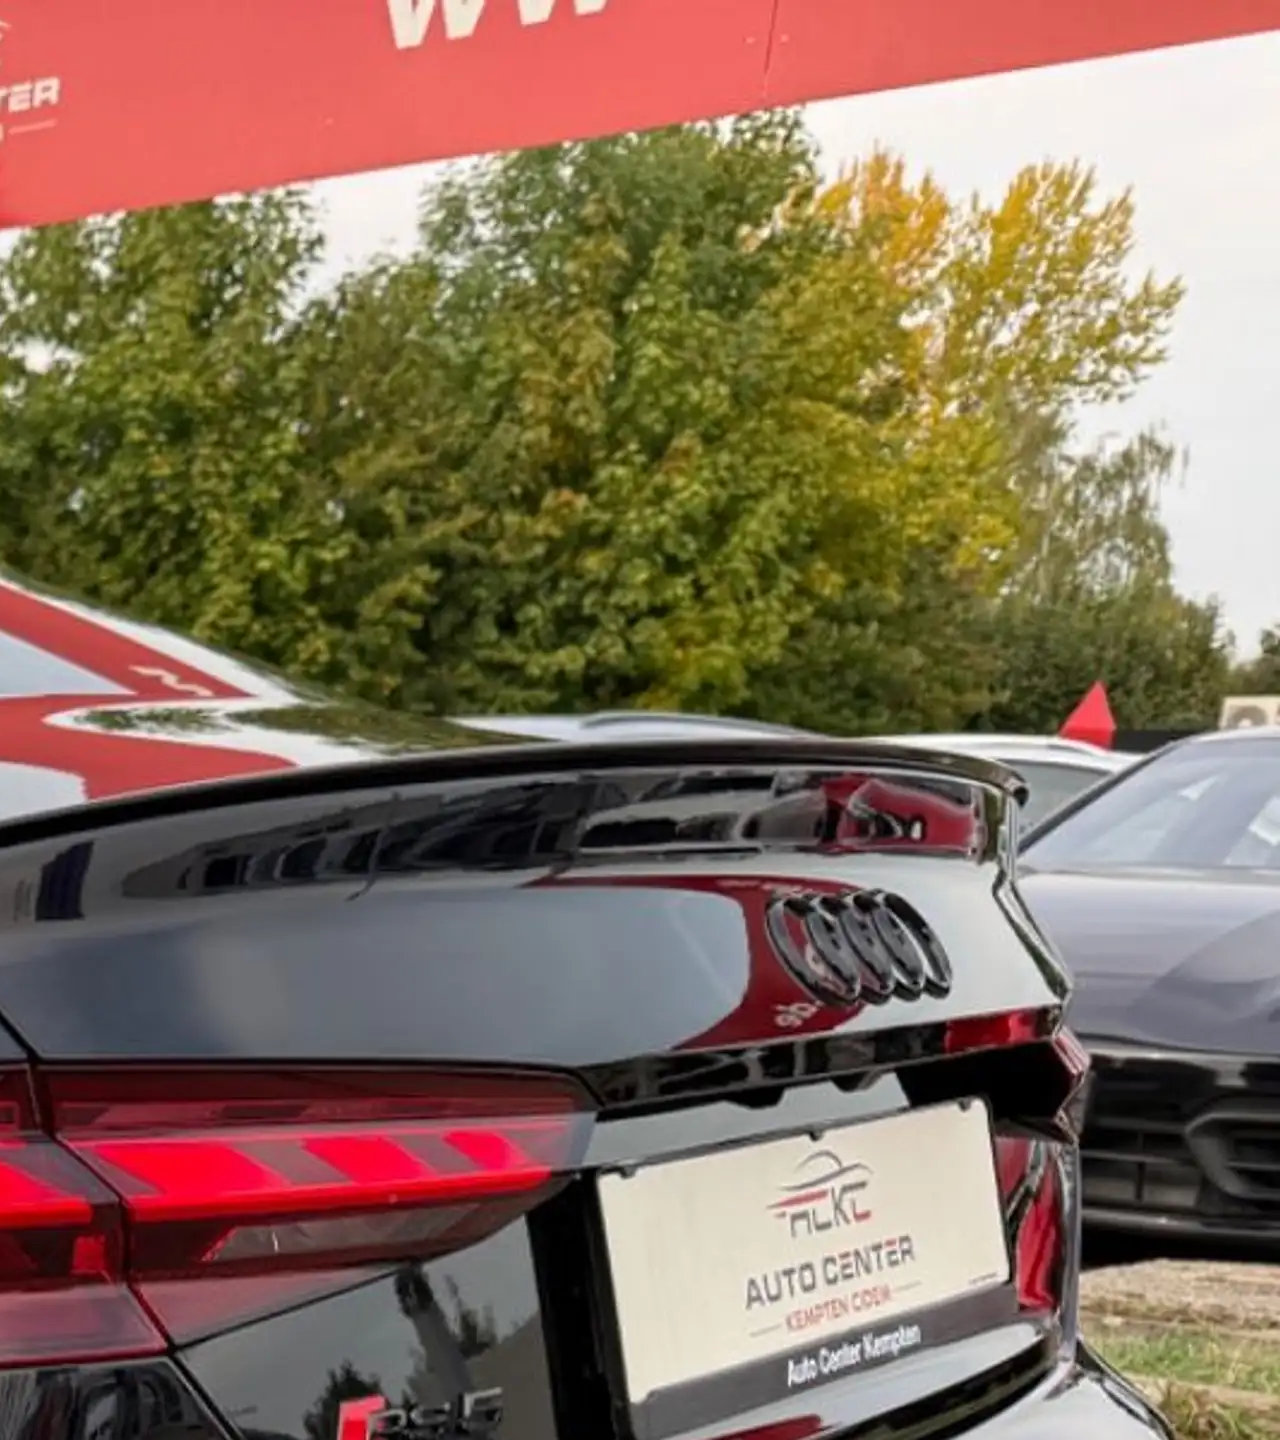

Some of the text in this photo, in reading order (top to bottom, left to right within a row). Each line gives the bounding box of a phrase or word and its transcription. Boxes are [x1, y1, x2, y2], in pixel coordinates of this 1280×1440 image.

[745, 1234, 915, 1311] AUTO CENTER
[785, 1299, 849, 1333] KEMPTEN
[787, 1323, 922, 1387] Auto Center Kempten
